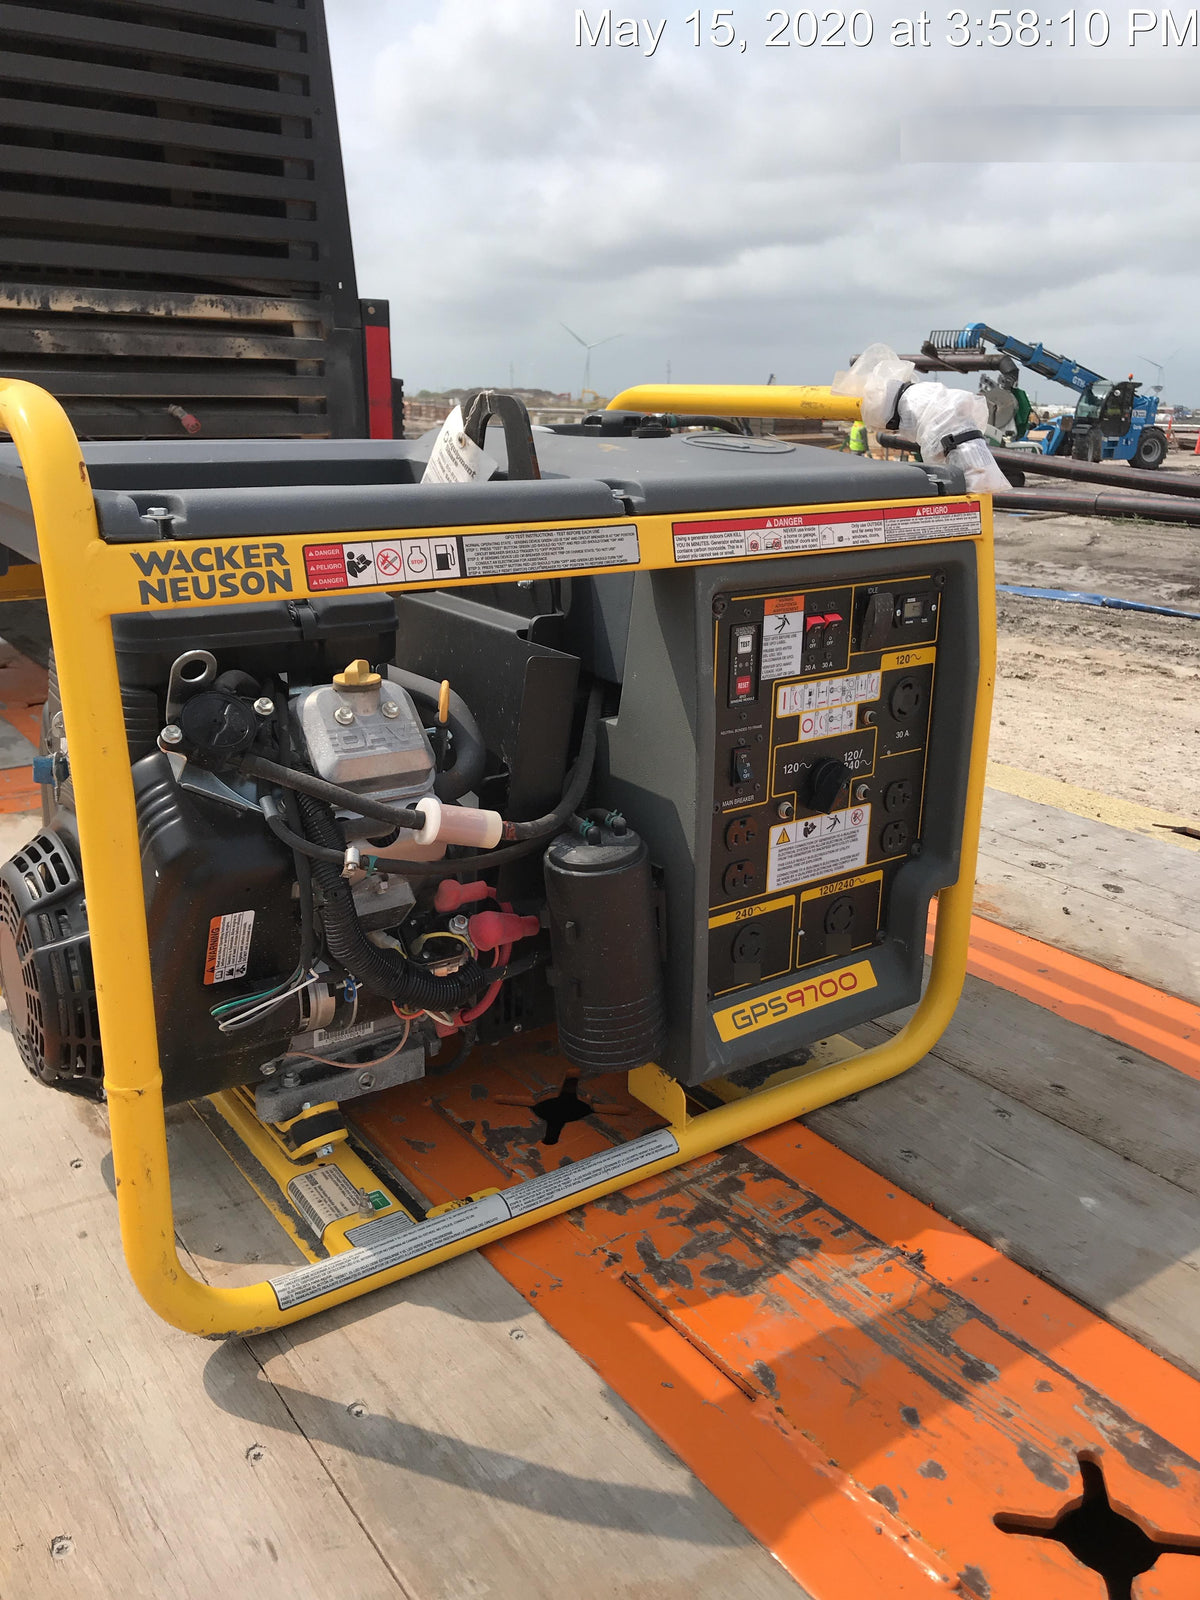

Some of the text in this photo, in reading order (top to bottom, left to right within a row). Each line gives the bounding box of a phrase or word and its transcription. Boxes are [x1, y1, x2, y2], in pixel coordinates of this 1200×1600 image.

[922, 506, 948, 515] PELIGRO
[773, 516, 804, 526] DANGER
[314, 548, 340, 557] DANGER
[129, 542, 290, 576] WACKER
[316, 563, 342, 571] PELIGRO
[138, 568, 293, 605] NEUSON
[896, 730, 904, 738] 30
[844, 748, 863, 761] 120/
[783, 763, 799, 774] 120
[734, 795, 754, 804] BREAKER
[208, 927, 220, 962] WARNING
[731, 972, 858, 1030] GPS9700
